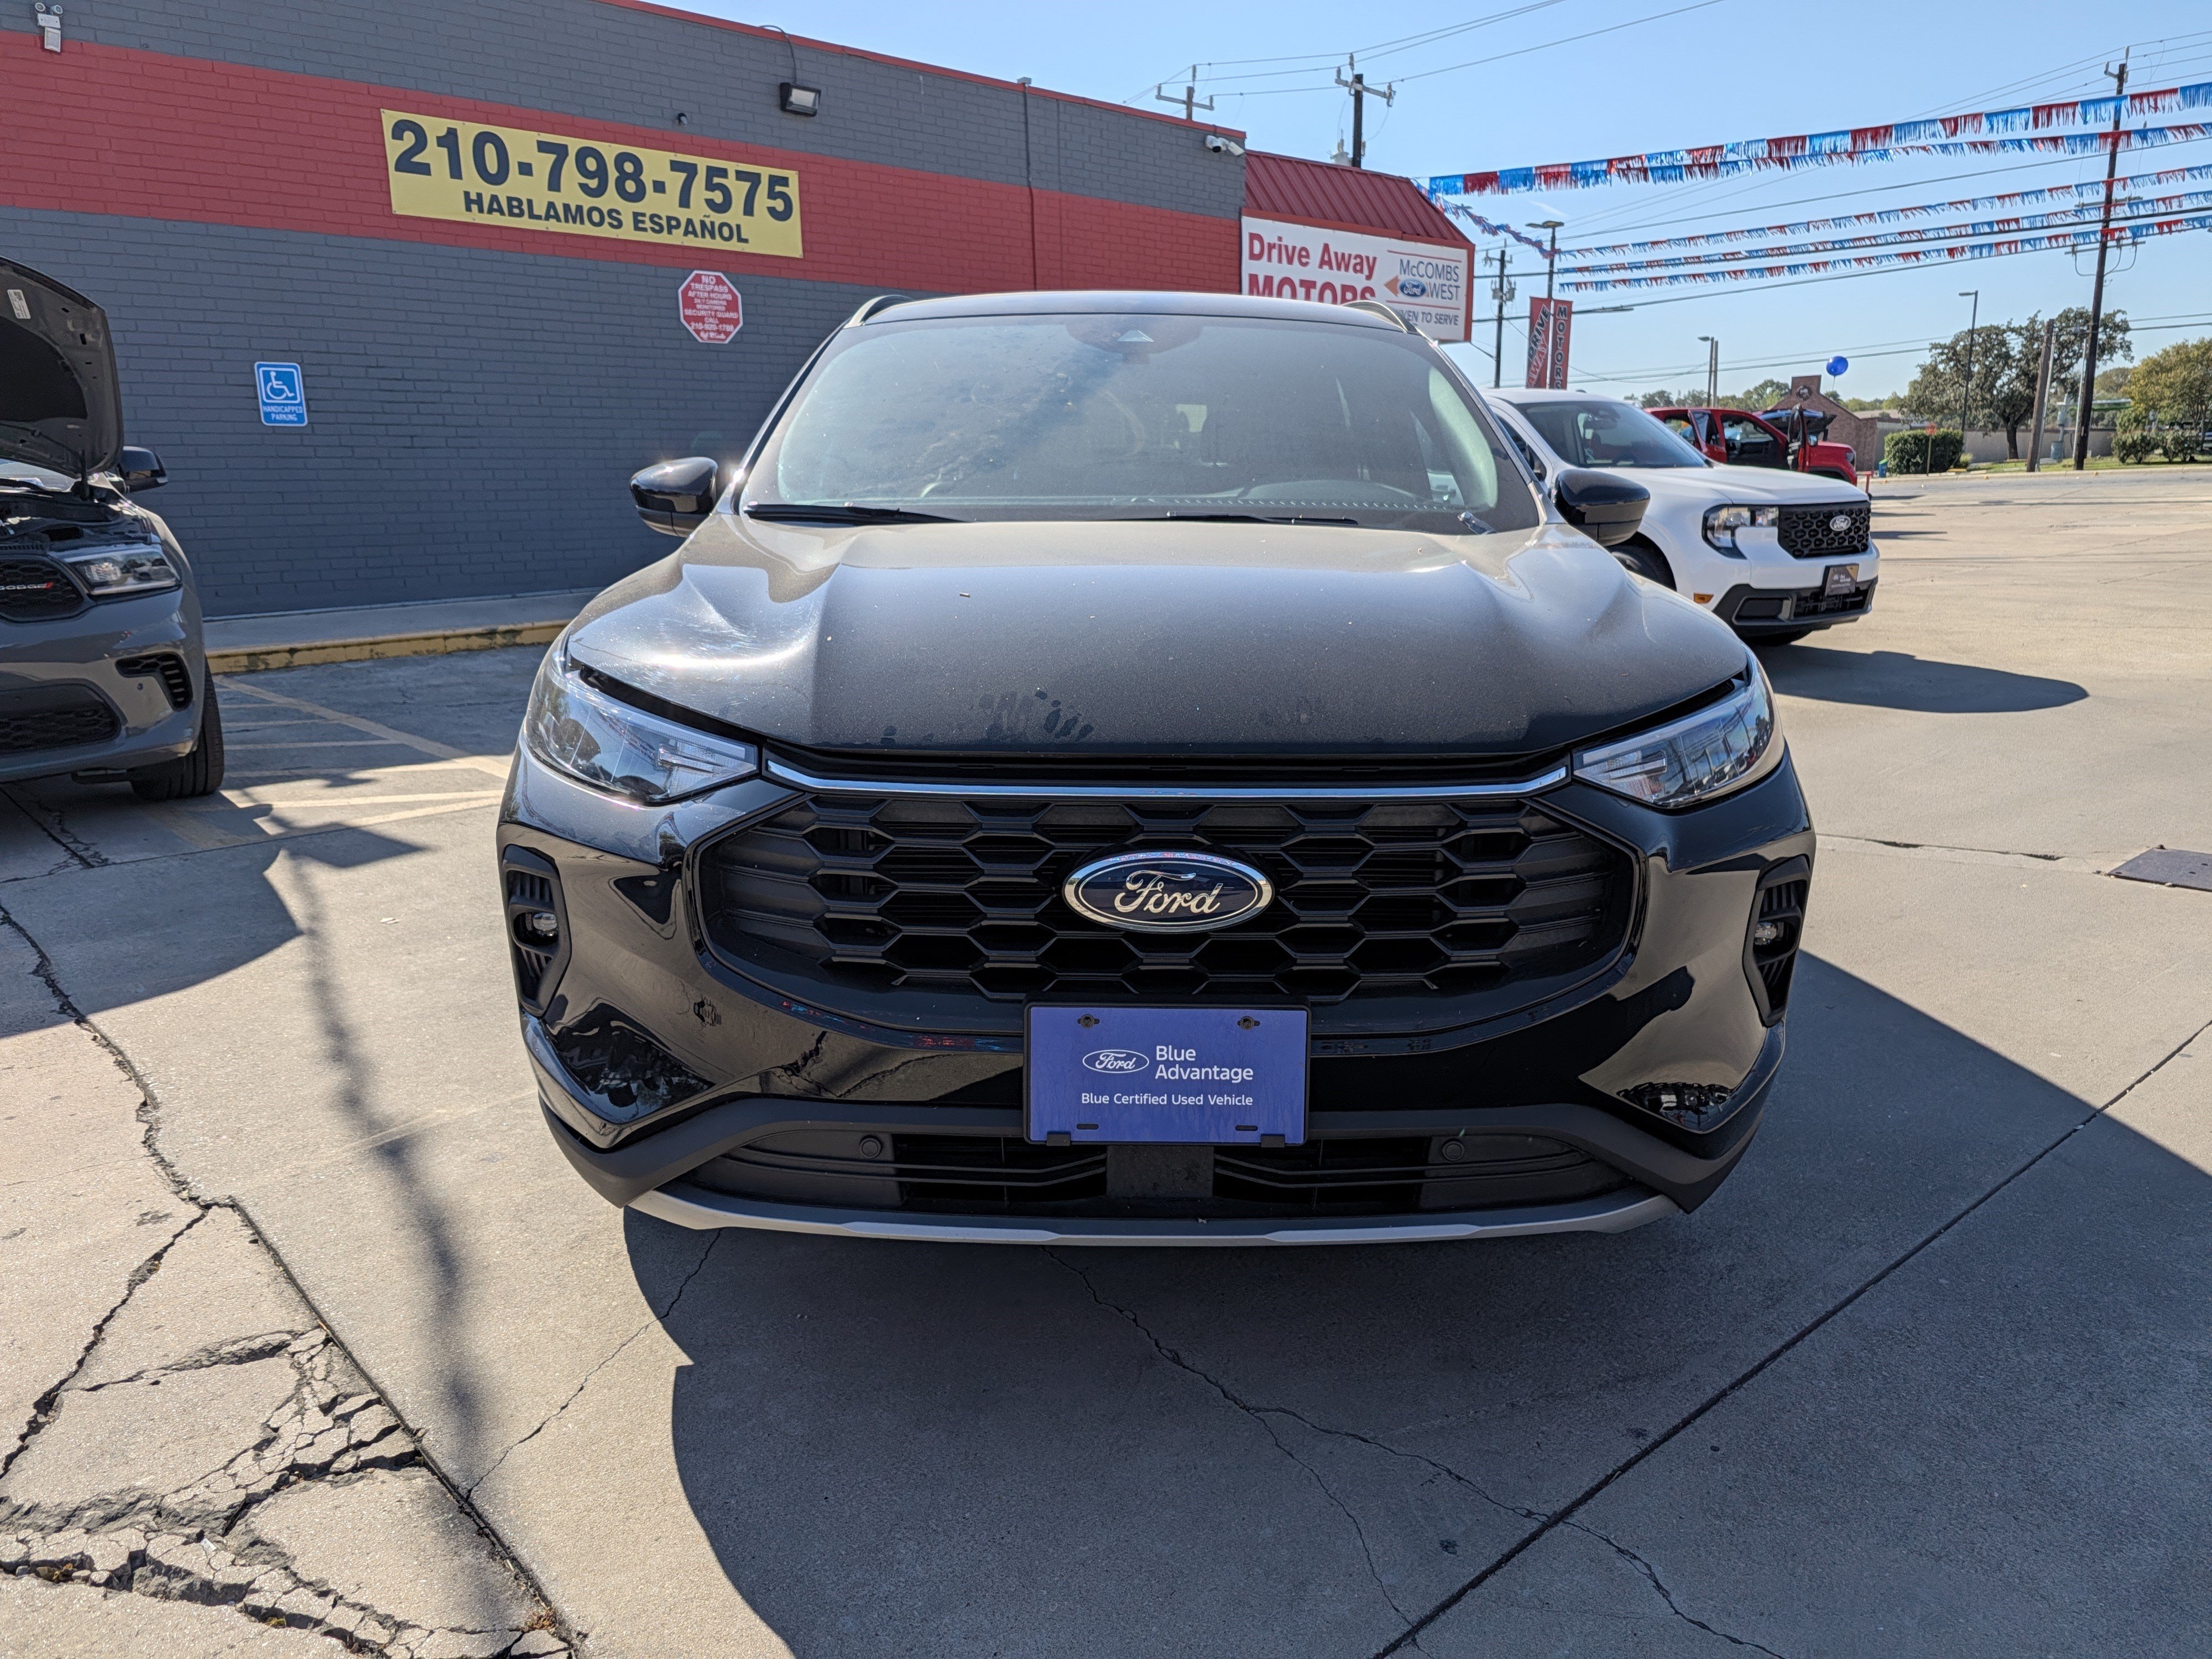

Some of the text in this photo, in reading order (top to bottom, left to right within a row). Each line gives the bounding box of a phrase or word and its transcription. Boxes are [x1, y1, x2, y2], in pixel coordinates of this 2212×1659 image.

[391, 118, 794, 222] 210-798-7575
[463, 190, 749, 244] HABLAMOS ESPAÑOL
[1248, 232, 1376, 281] Drive Away
[701, 275, 716, 284] NO
[1399, 258, 1459, 283] McCOMBS
[1429, 282, 1461, 301] WEST
[1421, 311, 1432, 324] TO
[1433, 314, 1459, 326] SERVE
[1527, 304, 1550, 362] DRIVE
[1114, 869, 1224, 914] Ford
[1095, 1052, 1137, 1070] Ford
[1156, 1045, 1197, 1061] Blue
[1155, 1064, 1254, 1083] Advantage
[1082, 1093, 1254, 1105] Blue Certified Used Vehicle
